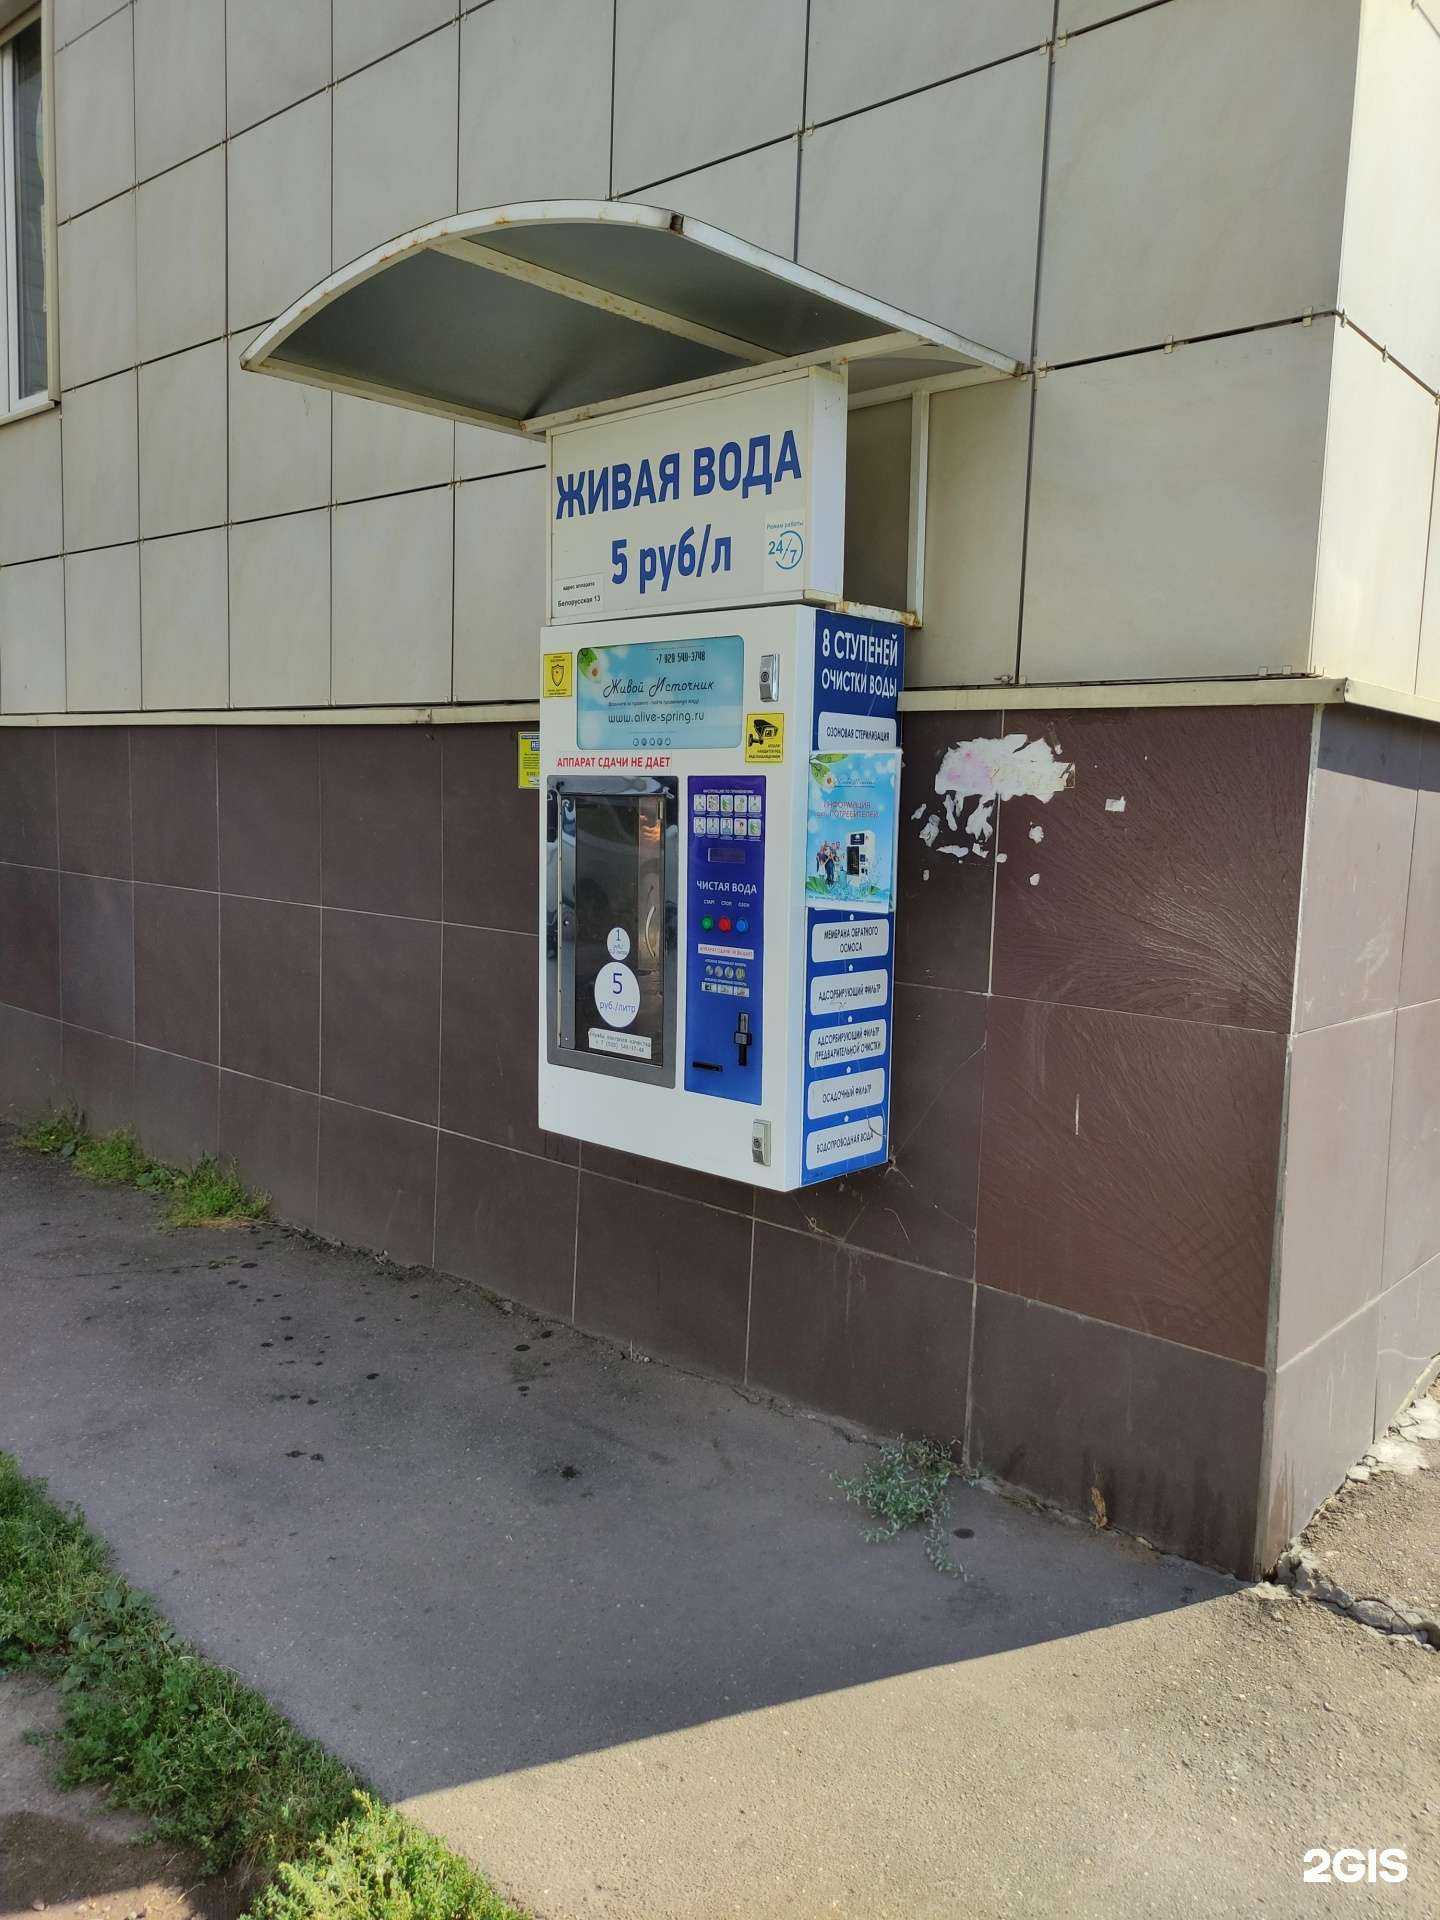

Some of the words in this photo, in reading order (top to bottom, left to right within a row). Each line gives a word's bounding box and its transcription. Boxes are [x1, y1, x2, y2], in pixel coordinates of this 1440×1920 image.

[556, 452, 680, 520] ЖИВАЯ
[693, 430, 802, 499] ВОДА
[611, 539, 628, 585] 5
[639, 523, 731, 594] руб/л
[768, 538, 798, 564] 24/7
[558, 598, 592, 607] Белорусская
[822, 628, 830, 657] 8
[834, 630, 898, 667] СТУПЕНЕЙ
[603, 677, 644, 698] Живой
[648, 675, 716, 698] Источник
[821, 668, 867, 693] ОЧИСТКИ
[869, 675, 897, 699] ВОДЫ
[608, 709, 705, 725] www.alive-spring.ru
[826, 726, 854, 739] ОЗОНОВАЯ
[854, 728, 890, 742] СТЕРИЛИЗАЦИЯ
[557, 757, 596, 767] АППАРАТ
[598, 757, 629, 769] СДАЧИ
[631, 757, 643, 767] НЕ
[645, 757, 671, 769] ДАЕТ
[696, 880, 730, 892] ЧИСТАЯ
[732, 883, 757, 895] ВОДА
[824, 929, 850, 940] МЕМБРАНА
[851, 926, 879, 938] ОБРАТНОГО
[840, 942, 862, 953] ОСМОСА
[612, 972, 623, 995] 5
[818, 984, 864, 1001] АДСОРБИРУЮЩИЙ
[864, 983, 881, 995] ФИЛЬТР
[817, 1028, 863, 1046] АДСОРБИРУЮЩИЙ
[863, 1027, 880, 1038] ФИЛЬТР
[815, 1042, 860, 1060] ПРЕДВАРИТЕЛЬНОЙ
[861, 1041, 881, 1053] ОЧИСТКИ
[822, 1085, 855, 1104] ОСАДОЧНЫЙ
[855, 1084, 872, 1095] ФИЛЬТР
[816, 1134, 860, 1154] ВОДОПРОВОДНАЯ
[861, 1130, 874, 1143] ВОДА
